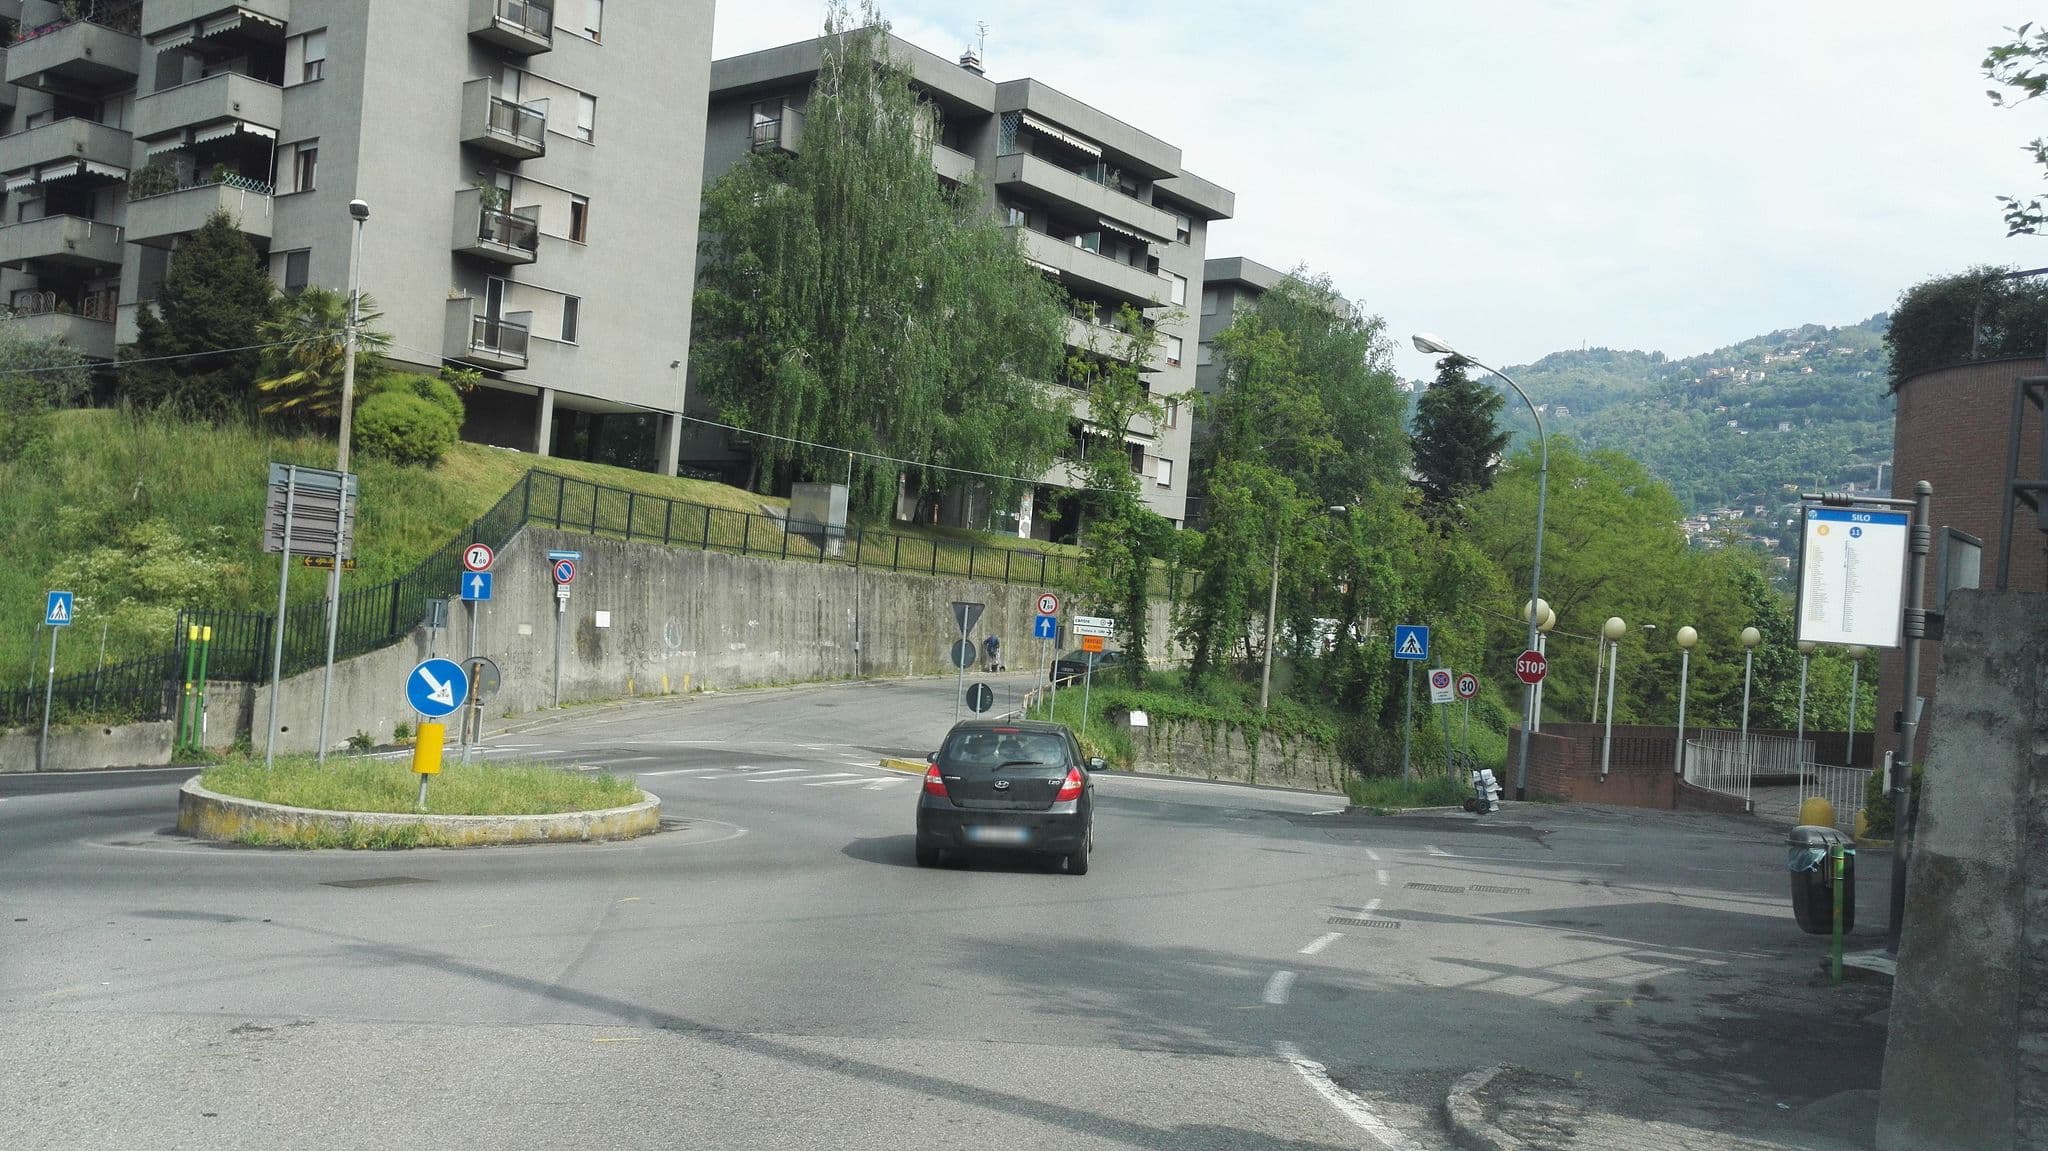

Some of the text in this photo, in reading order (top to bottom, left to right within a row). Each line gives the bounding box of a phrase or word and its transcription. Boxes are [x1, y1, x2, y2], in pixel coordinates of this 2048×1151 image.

[1851, 513, 1871, 522] SILO
[1518, 660, 1546, 675] STOP
[1461, 680, 1474, 692] 30
